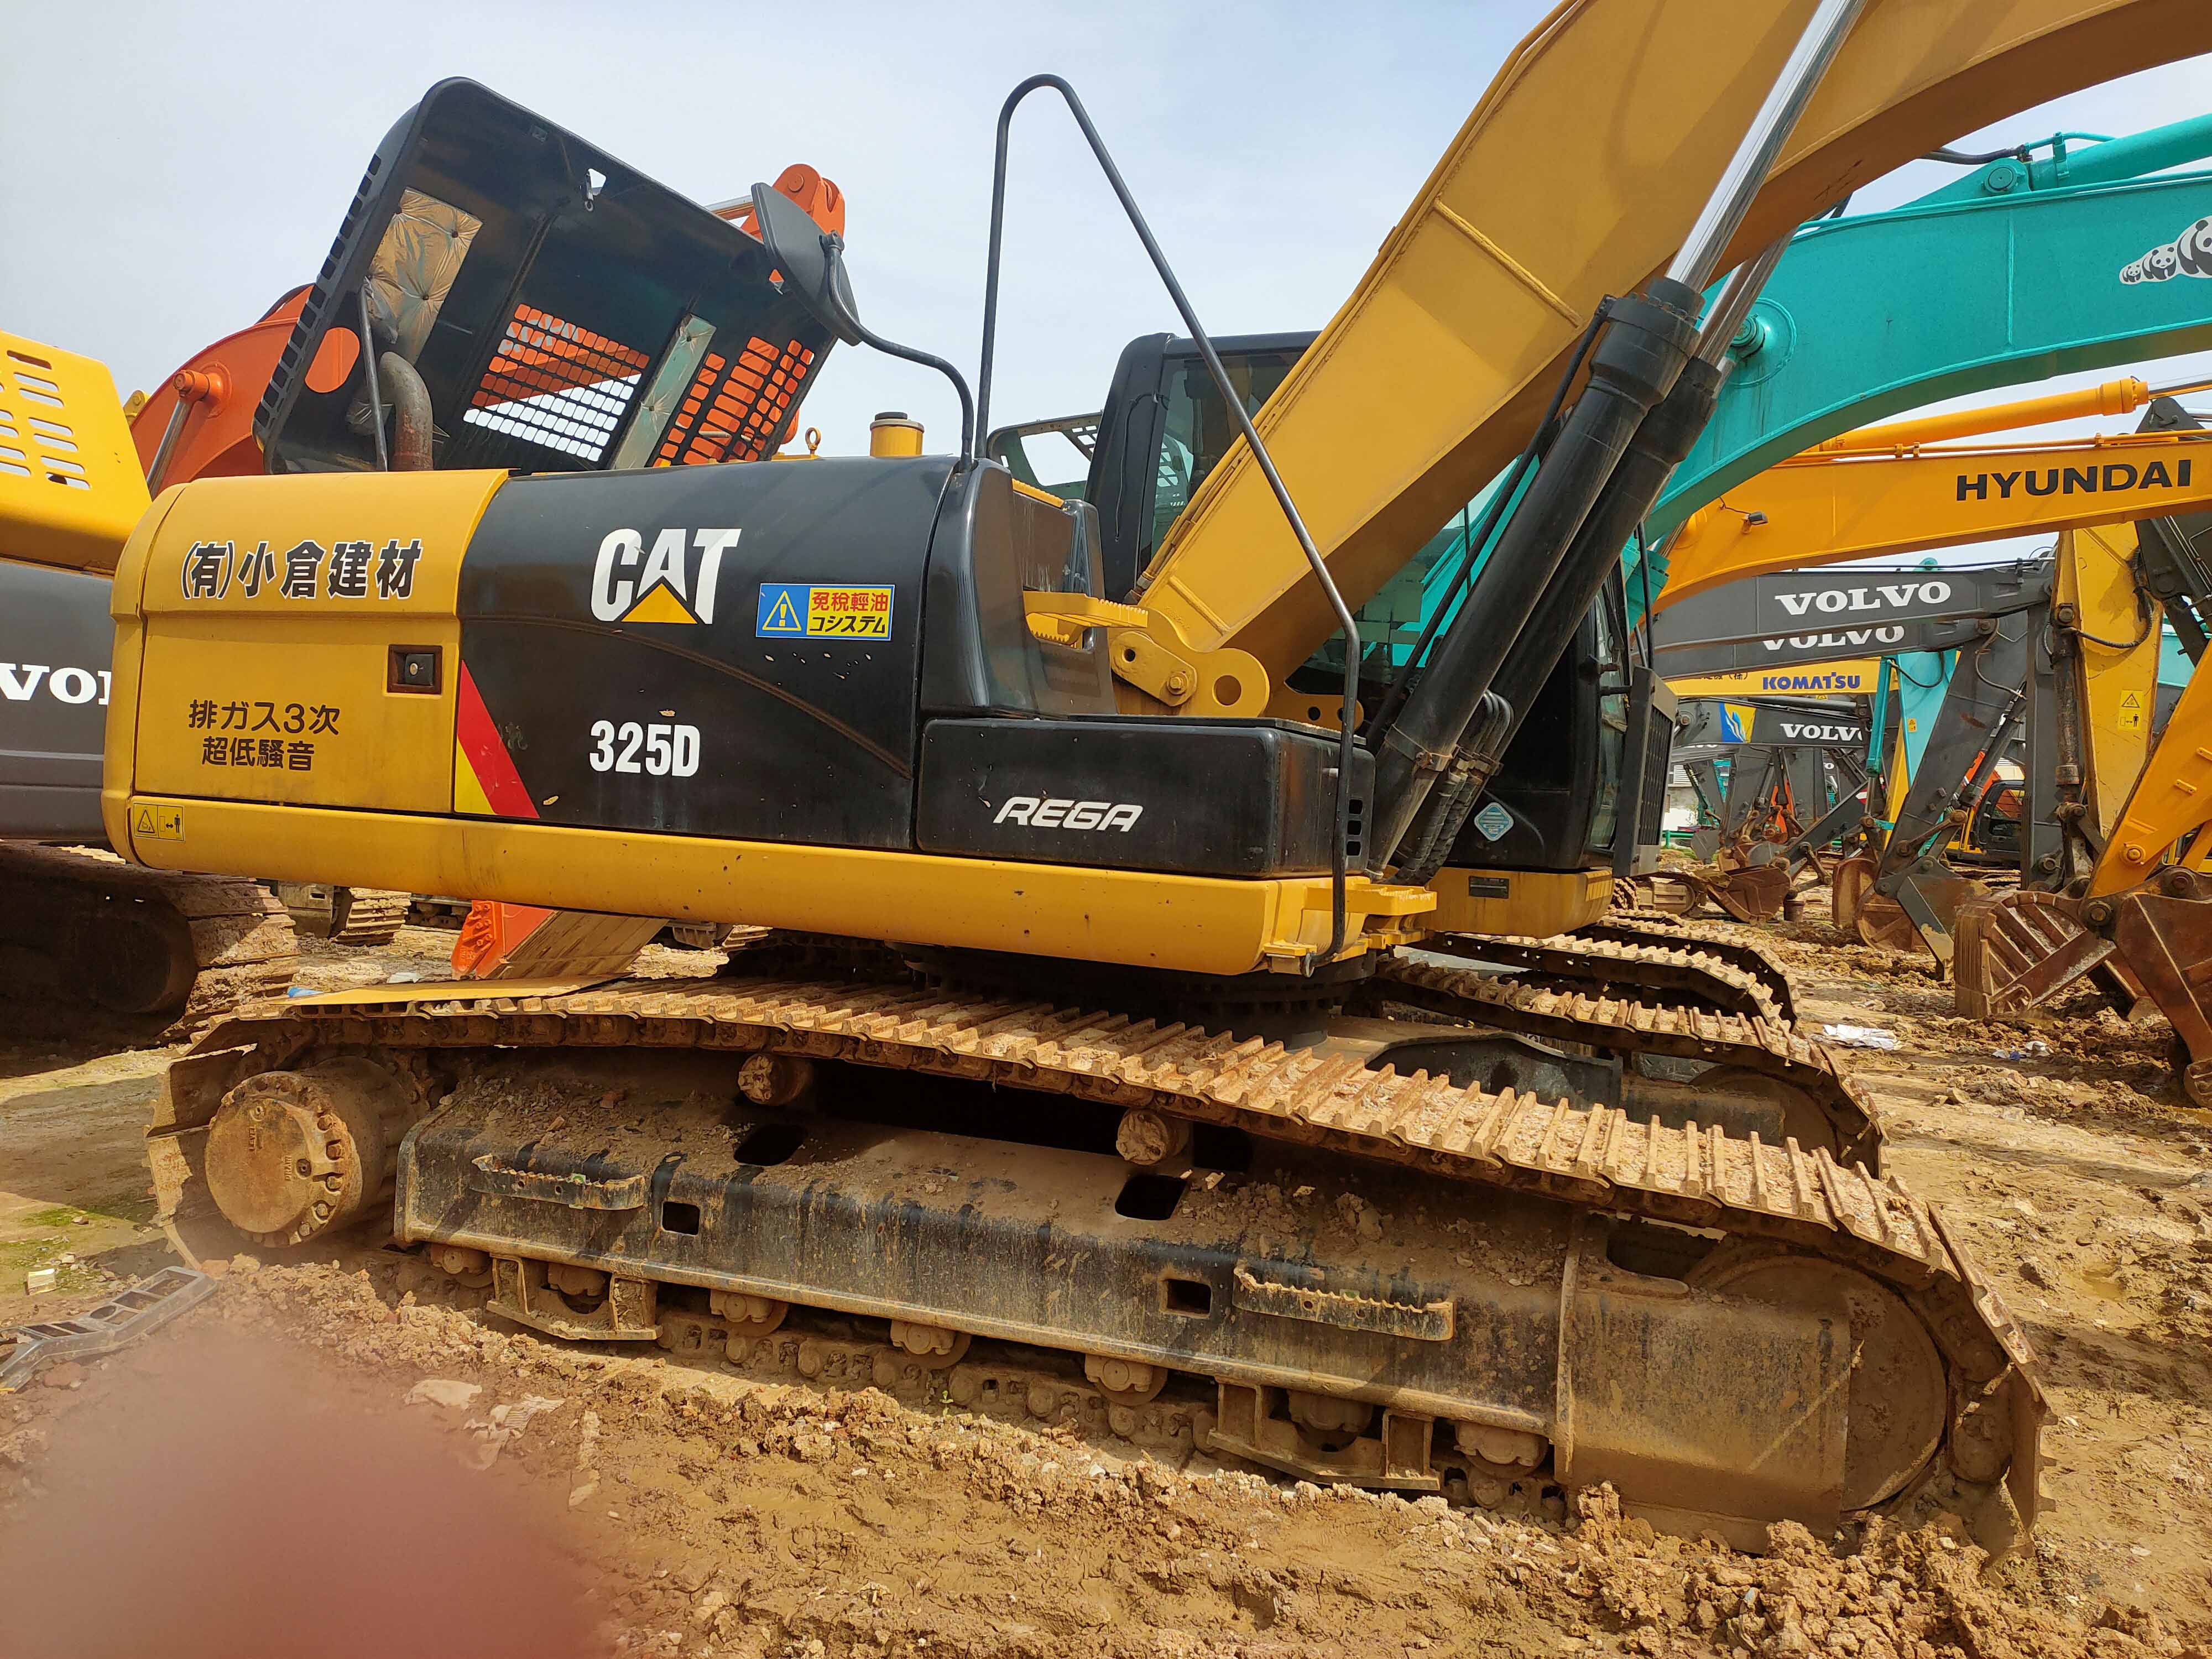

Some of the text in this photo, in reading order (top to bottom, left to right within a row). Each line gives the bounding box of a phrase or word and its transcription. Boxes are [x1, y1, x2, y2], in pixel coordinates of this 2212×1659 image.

[1956, 459, 2192, 501] HYUNDAI
[181, 539, 422, 599] (有)小倉建材
[591, 528, 742, 624] CAT
[1774, 581, 1951, 615] VOLVO
[809, 615, 885, 634] コシステム
[1762, 672, 1861, 690] KOMATSU
[188, 699, 340, 735] 排ガス3次
[1780, 723, 1863, 742] VOLV
[201, 735, 315, 771] 超低騒音
[589, 720, 701, 777] 325D
[993, 796, 1143, 832] REGA
